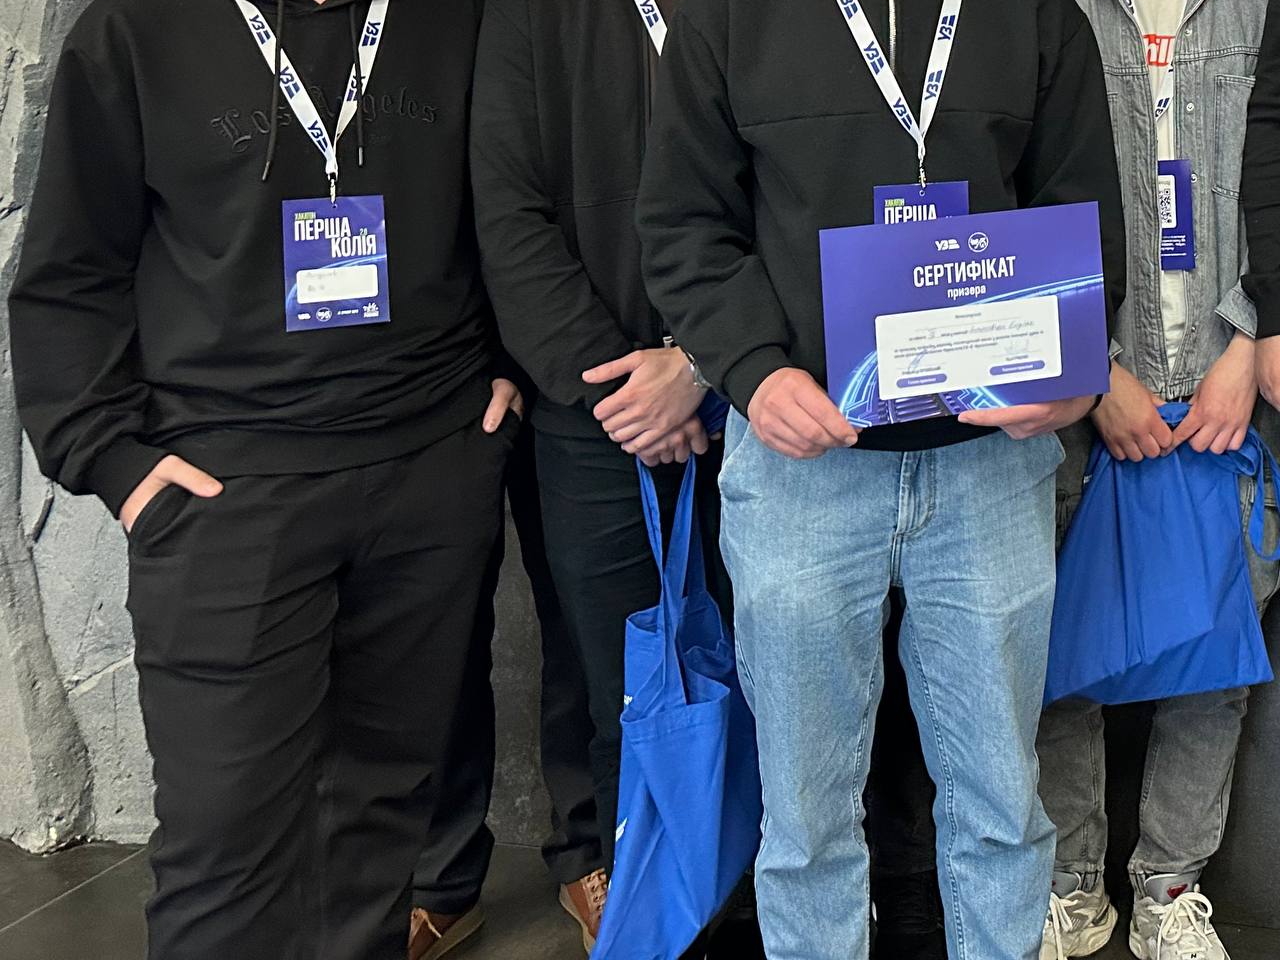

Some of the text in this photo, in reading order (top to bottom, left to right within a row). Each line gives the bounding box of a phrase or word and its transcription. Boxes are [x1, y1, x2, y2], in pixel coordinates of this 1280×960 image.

[294, 217, 352, 241] ПЕРША
[331, 234, 377, 258] КОЛІЯ
[913, 255, 1016, 288] СЕРТИФІКАТ
[947, 284, 986, 300] призера
